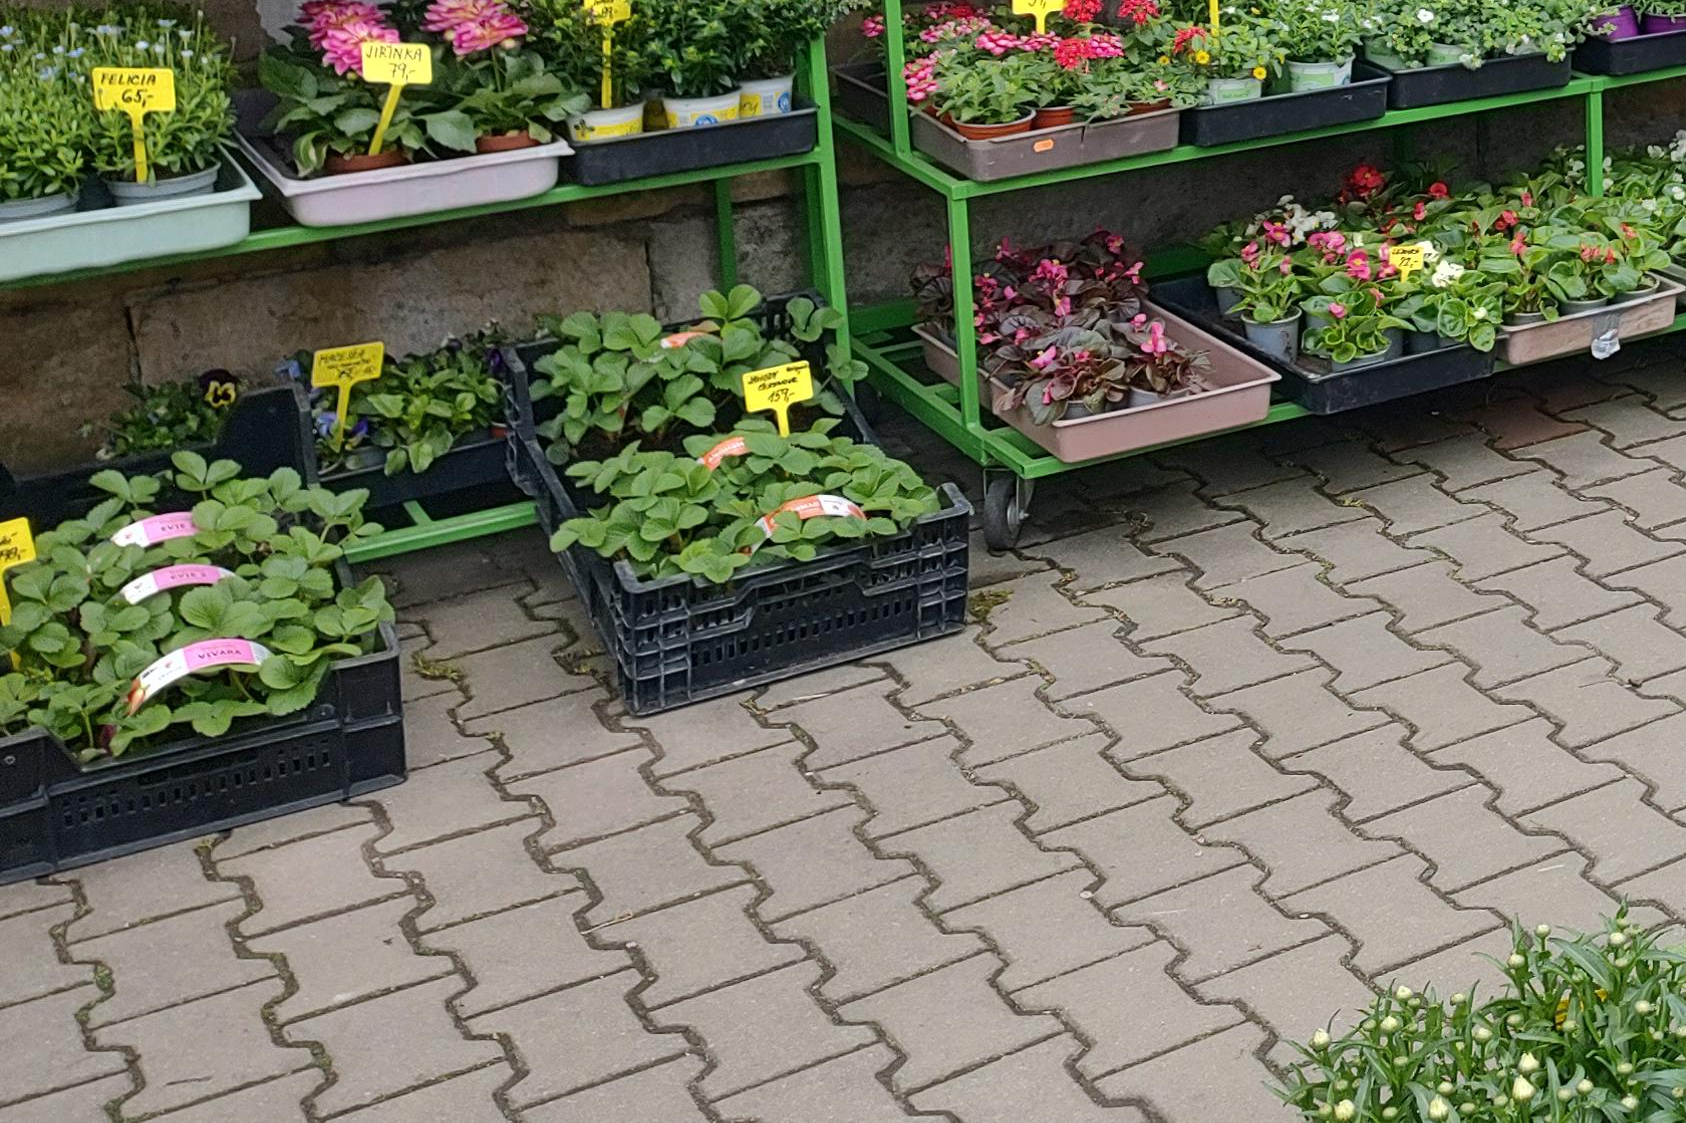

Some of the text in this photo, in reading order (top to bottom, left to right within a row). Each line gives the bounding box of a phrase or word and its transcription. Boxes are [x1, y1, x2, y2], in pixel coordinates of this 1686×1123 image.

[388, 61, 416, 81] 79,-
[100, 73, 157, 85] FELICIA
[121, 88, 154, 108] 65,-
[160, 523, 185, 532] EVIE
[197, 649, 242, 660] VIVARA
